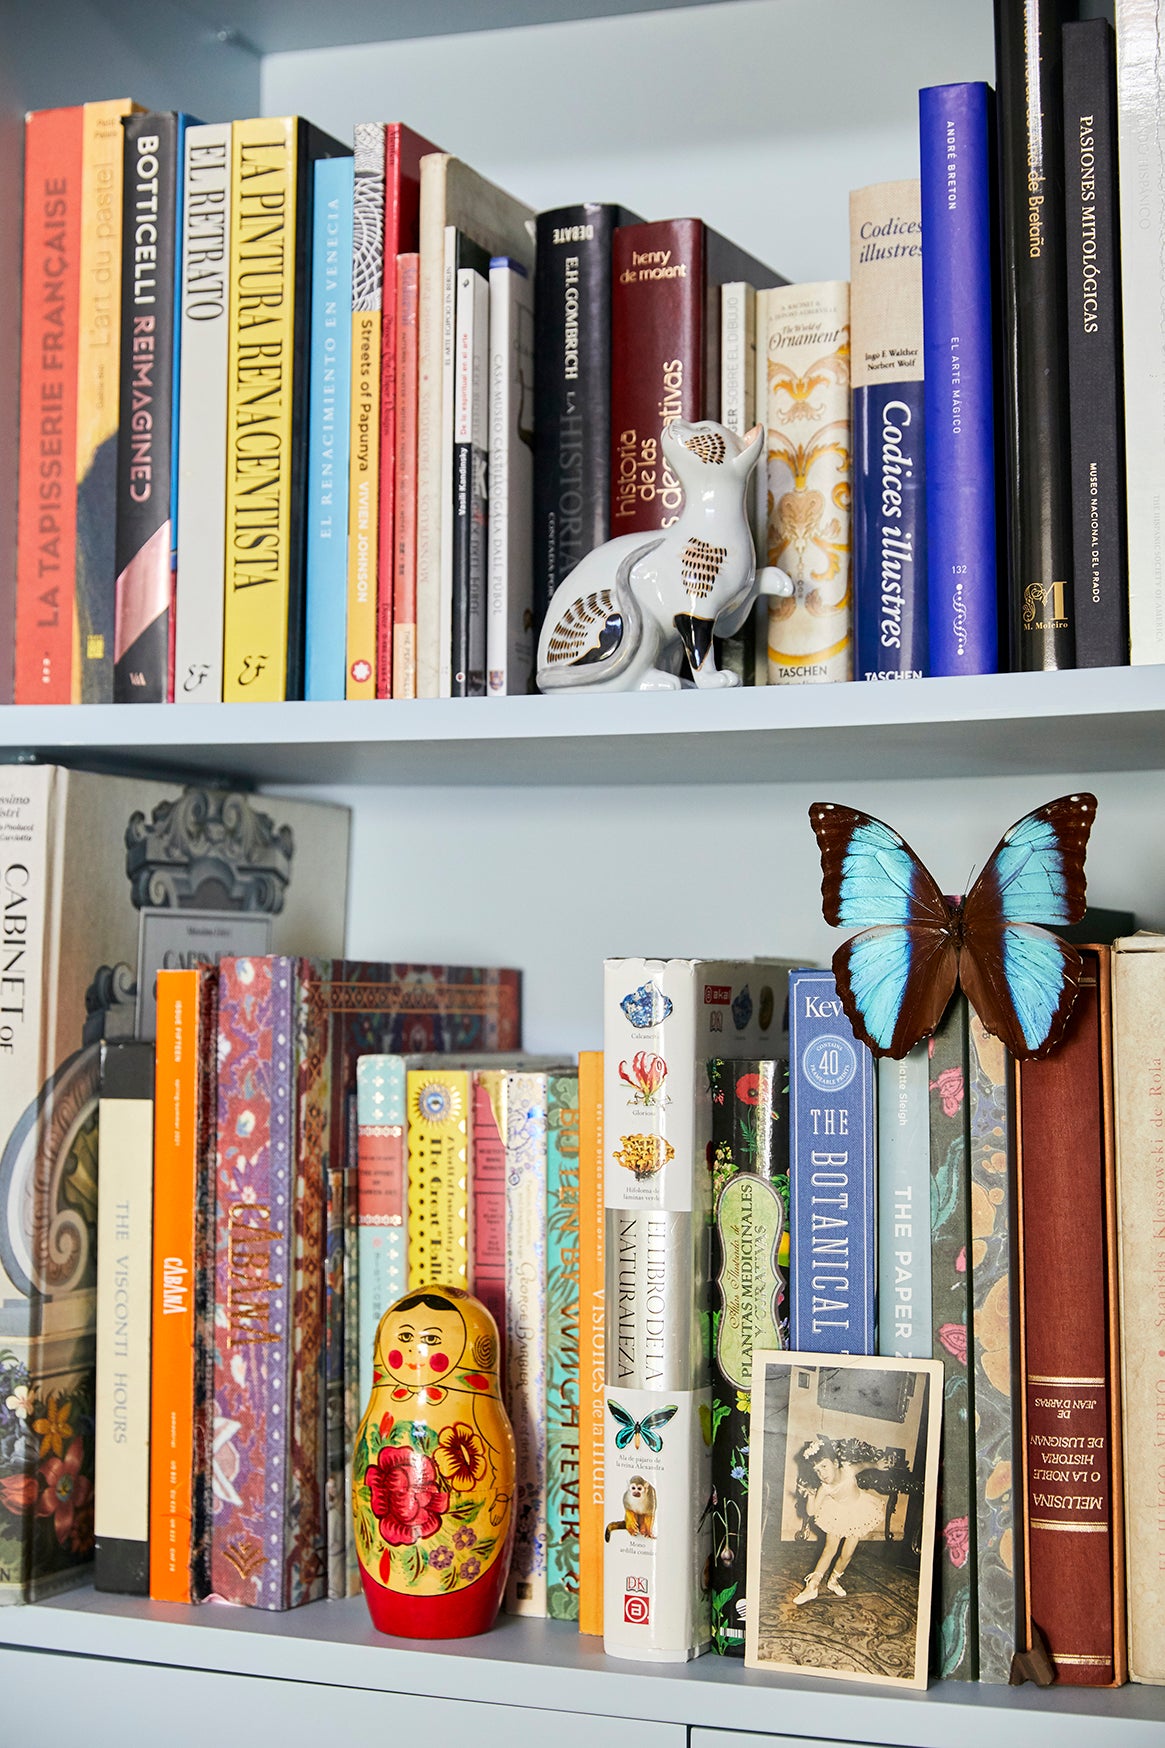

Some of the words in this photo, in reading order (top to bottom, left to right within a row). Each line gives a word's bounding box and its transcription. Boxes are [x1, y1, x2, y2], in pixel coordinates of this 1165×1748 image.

[946, 120, 958, 160] ANDRÉ
[189, 143, 226, 182] EL
[240, 140, 286, 183] LA
[1080, 114, 1096, 202] PASIONES
[947, 164, 957, 210] BRETON
[1028, 171, 1046, 192] de
[93, 162, 117, 240] pastel
[134, 135, 159, 305] BOTTICELLI
[552, 224, 594, 244] DEBATE
[860, 217, 922, 240] Codices
[1029, 195, 1045, 258] Bretaña
[186, 190, 225, 320] RETRATO
[238, 189, 286, 333] PINTURA
[326, 198, 340, 291] VENECIA
[632, 250, 671, 266] henry
[859, 244, 922, 264] illustres
[42, 177, 67, 370] FRANÇAISE
[91, 249, 112, 284] du
[620, 270, 638, 284] de
[639, 264, 687, 280] morant
[1081, 206, 1100, 333] MITOLÓGICAS
[325, 301, 338, 328] EN
[446, 293, 452, 304] EN
[88, 298, 109, 348] L'art
[565, 288, 579, 380] GOMBRICH
[727, 296, 739, 342] DIBUJO
[782, 325, 793, 334] The
[816, 322, 822, 331] of
[360, 319, 373, 376] Streets
[462, 352, 468, 360] el
[728, 346, 739, 360] EL
[768, 329, 841, 350] Ornament
[864, 351, 880, 362] Ingo
[889, 348, 918, 357] Walther
[951, 336, 960, 350] EL
[444, 358, 450, 366] EL
[462, 361, 467, 372] en
[867, 361, 895, 371] Norbert
[898, 359, 916, 368] Wolf
[952, 356, 960, 384] ARTE
[360, 381, 372, 397] of
[460, 374, 468, 411] espiritual
[728, 363, 739, 405] SOBRE
[130, 315, 156, 502] REIMAGINED
[460, 412, 467, 420] lo
[566, 391, 576, 414] LA
[952, 390, 962, 434] MÁGICO
[320, 338, 337, 506] RENACIMIENTO
[356, 404, 372, 472] Papunya
[420, 392, 432, 472] PRODIGIOS
[460, 422, 466, 435] De
[234, 339, 283, 592] RENACENTISTA
[493, 437, 503, 496] CASTILLO
[638, 438, 656, 466] las
[881, 400, 913, 518] Codices
[39, 382, 64, 579] TAPISSERIE
[420, 480, 430, 488] Y
[458, 448, 468, 493] Kandinsky
[616, 429, 637, 518] historia
[638, 470, 656, 501] de
[1090, 462, 1098, 496] MUSEO
[358, 481, 369, 529] VIVIEN
[458, 493, 467, 516] Vasili
[558, 415, 584, 577] HISTORIA
[320, 515, 332, 540] EL
[493, 500, 502, 534] GALA
[1090, 498, 1099, 548] NACIONAL
[420, 494, 430, 583] MONSTRUOS
[357, 535, 368, 603] JOHNSON
[951, 565, 968, 574] 132
[1091, 550, 1100, 569] DEL
[1153, 552, 1162, 588] SOCIETY
[880, 525, 913, 649] illustres
[1092, 572, 1100, 603] PRADO
[38, 587, 59, 628] LA
[1154, 602, 1163, 642] AMERICA
[1023, 622, 1033, 630] M.
[1035, 622, 1068, 630] Moleiro
[778, 666, 828, 678] TASCHEN
[864, 670, 922, 681] TASCHEN
[1, 863, 30, 1023] CABINET
[0, 1026, 14, 1055] OF
[174, 1028, 182, 1062] FIFTEEN
[816, 1042, 844, 1051] CONTAINS
[810, 1064, 836, 1086] FRAMEABLE
[834, 1064, 850, 1084] PRINTS
[819, 1050, 839, 1076] 40
[1148, 1057, 1162, 1097] Rola
[810, 1108, 848, 1135] THE
[898, 1093, 908, 1126] Sleigh
[1150, 1106, 1163, 1128] de
[431, 1138, 442, 1165] The
[431, 1176, 442, 1225] Great
[1150, 1139, 1165, 1239] Klossowski
[115, 1203, 130, 1241] THE
[894, 1186, 912, 1238] THE
[596, 1228, 602, 1240] OF
[647, 1222, 666, 1244] EL
[733, 1224, 740, 1236] de
[741, 1184, 752, 1298] MEDICINALES
[811, 1150, 850, 1334] BOTANICAL
[226, 1204, 284, 1349] CABANA
[560, 1248, 579, 1283] BY
[646, 1249, 666, 1314] LIBRO
[727, 1240, 740, 1290] Ilustrado
[754, 1224, 767, 1324] CURATIVAS
[163, 1257, 188, 1315] CABANA
[618, 1219, 637, 1379] NATURALEZA
[894, 1251, 912, 1338] PAPER
[1153, 1251, 1165, 1327] Stanislas
[114, 1255, 130, 1358] VISCONTI
[730, 1295, 740, 1330] Atlas
[646, 1319, 665, 1348] DE
[741, 1302, 752, 1378] PLANTAS
[754, 1326, 766, 1338] Y
[646, 1355, 664, 1380] LA
[114, 1372, 128, 1444] HOURS
[1035, 1398, 1070, 1409] D'ARRAS
[1057, 1410, 1071, 1419] DE
[1072, 1400, 1096, 1410] JEAN
[1031, 1435, 1084, 1448] LUSIGNAN
[1088, 1438, 1104, 1448] DE
[1033, 1469, 1070, 1482] NOBLE
[1042, 1453, 1094, 1466] HISTORIA
[1073, 1471, 1087, 1482] LA
[1091, 1472, 1100, 1482] O
[560, 1444, 579, 1543] FEVER
[1033, 1493, 1103, 1510] MELUSINA
[627, 1576, 646, 1590] DK
